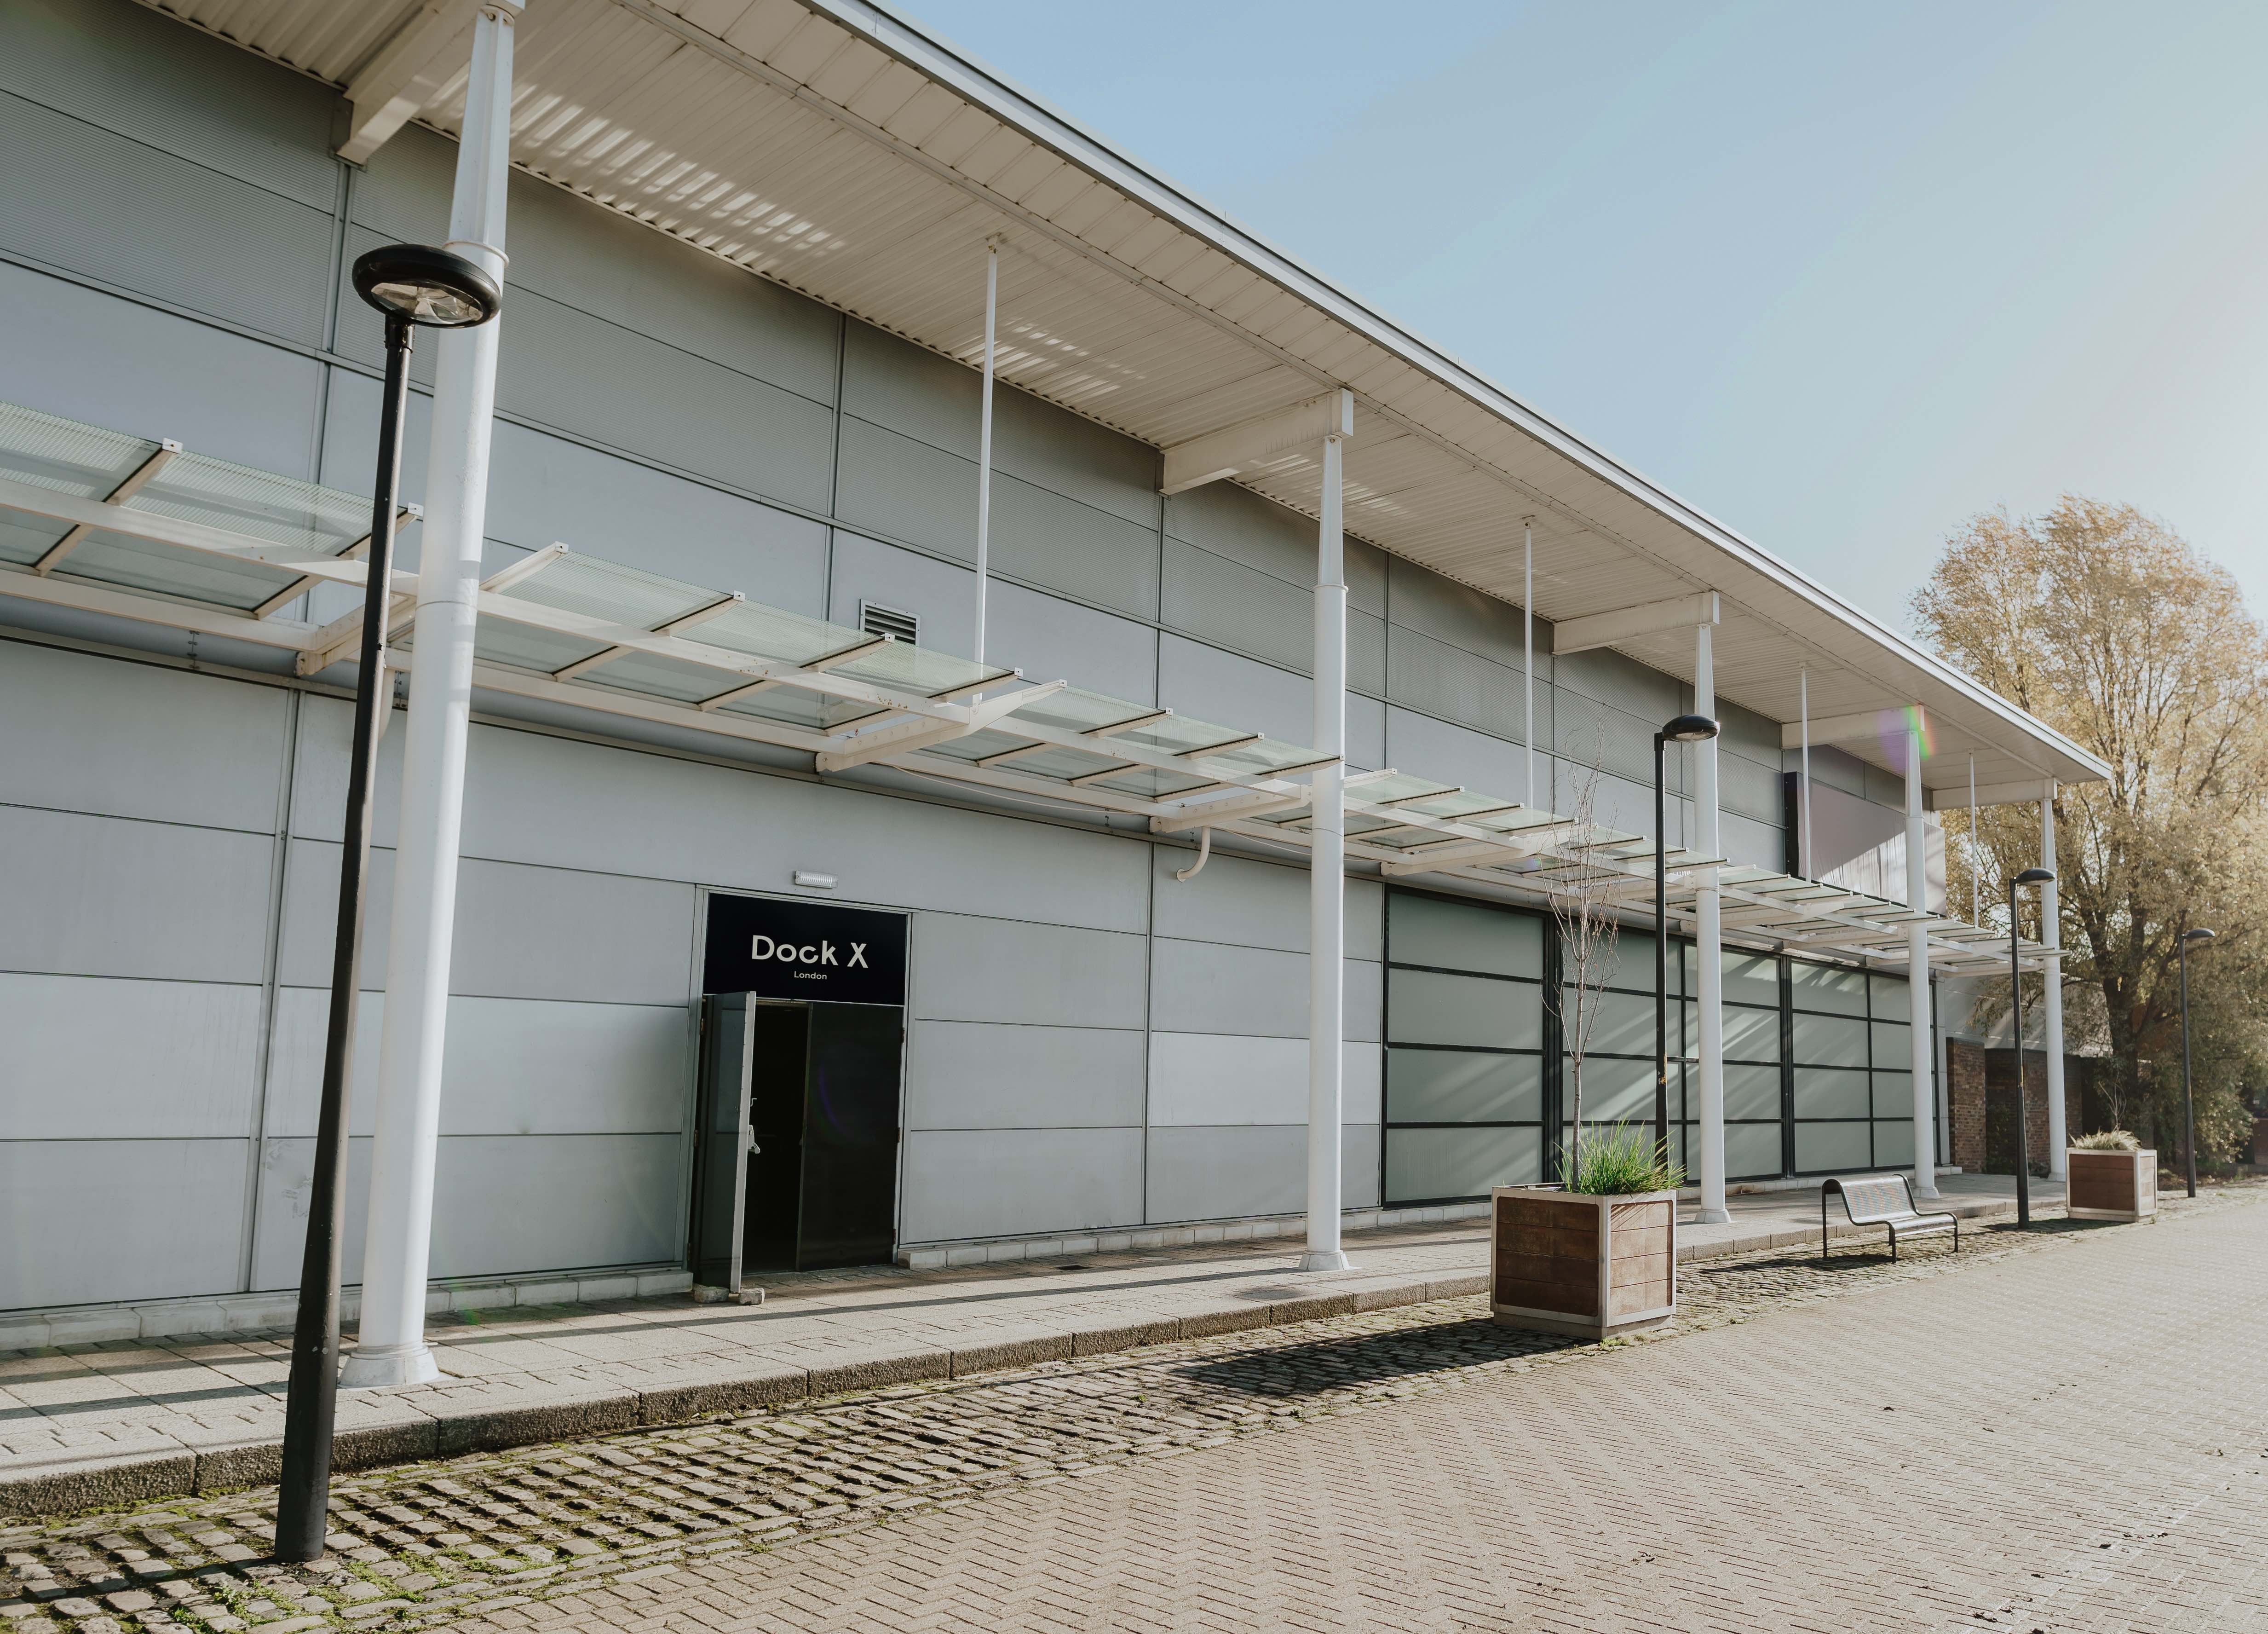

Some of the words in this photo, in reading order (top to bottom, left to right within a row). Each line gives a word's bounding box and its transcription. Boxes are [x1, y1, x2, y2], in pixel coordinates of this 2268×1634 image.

[752, 935, 839, 965] Dock
[847, 942, 869, 968] X
[794, 971, 827, 980] London
